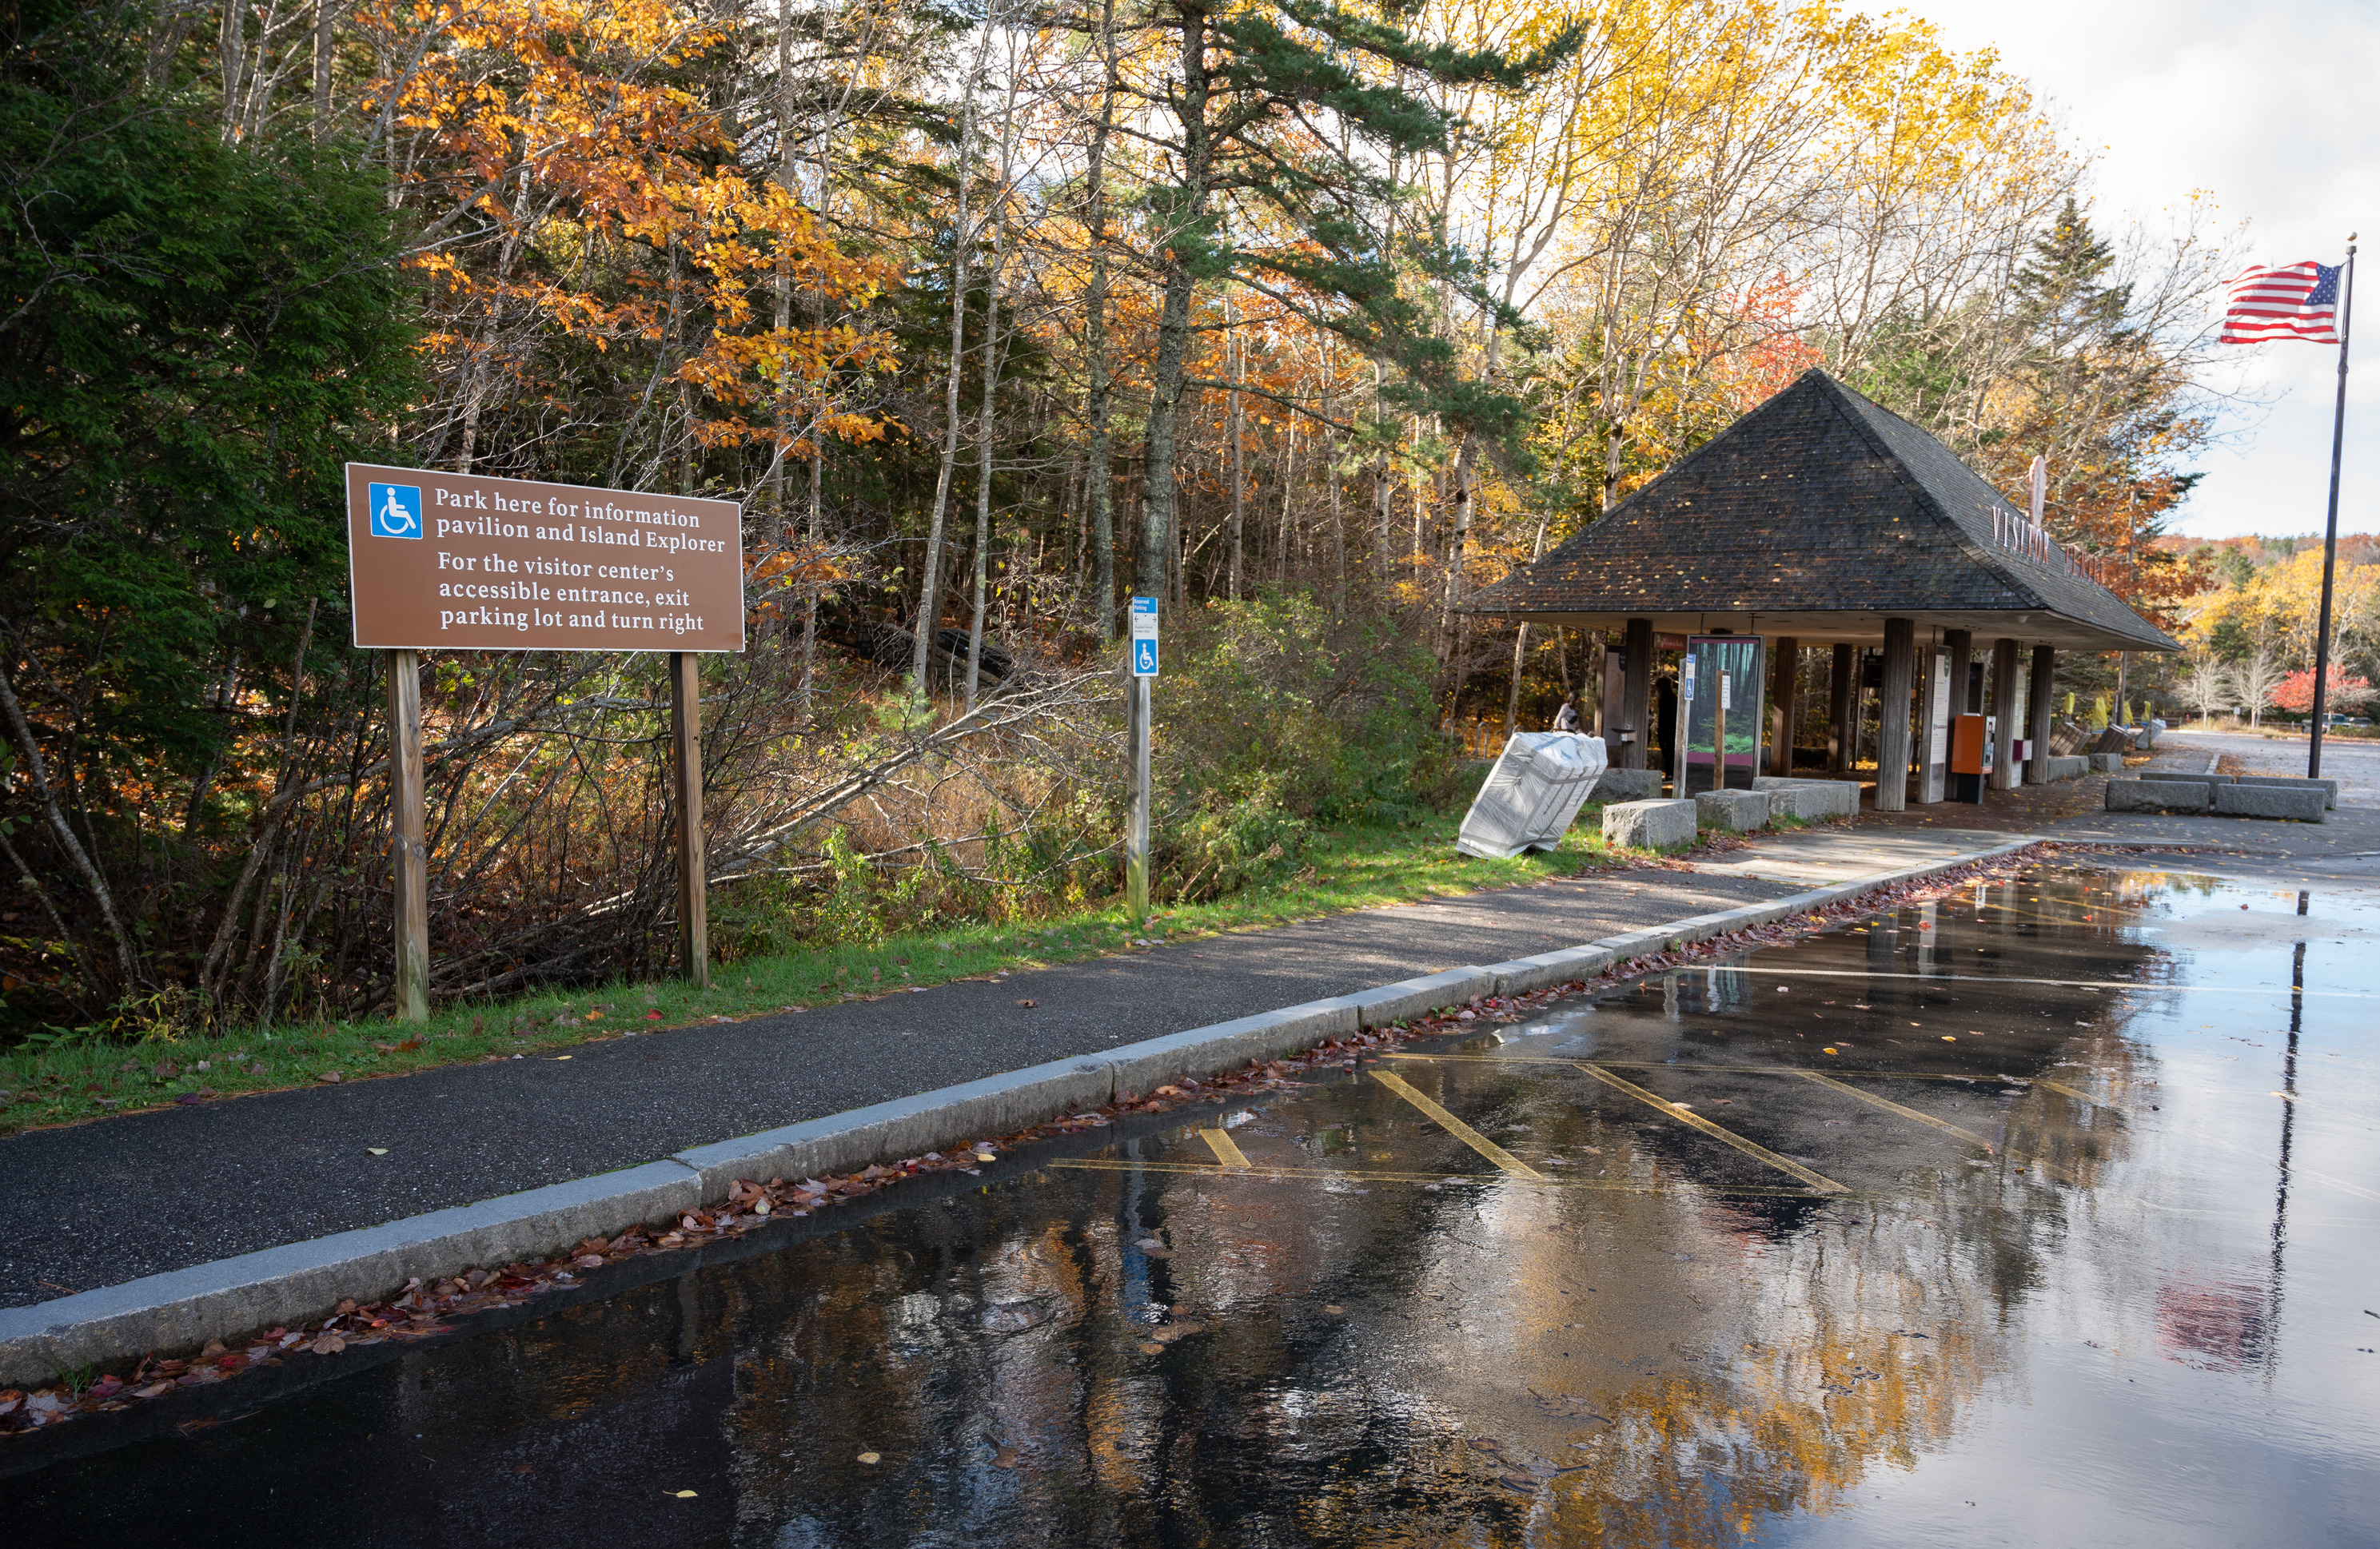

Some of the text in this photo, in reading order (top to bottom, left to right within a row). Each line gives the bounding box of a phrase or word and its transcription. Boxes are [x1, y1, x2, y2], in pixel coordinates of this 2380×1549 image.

[434, 488, 700, 528] Park here for information
[436, 516, 726, 555] pavilion and Island Explorer
[1992, 506, 2049, 564] VISITOR
[437, 552, 674, 582] For the visitor center’s
[439, 580, 690, 607] accessible entrance, exit
[440, 605, 704, 635] parking lot and turn right
